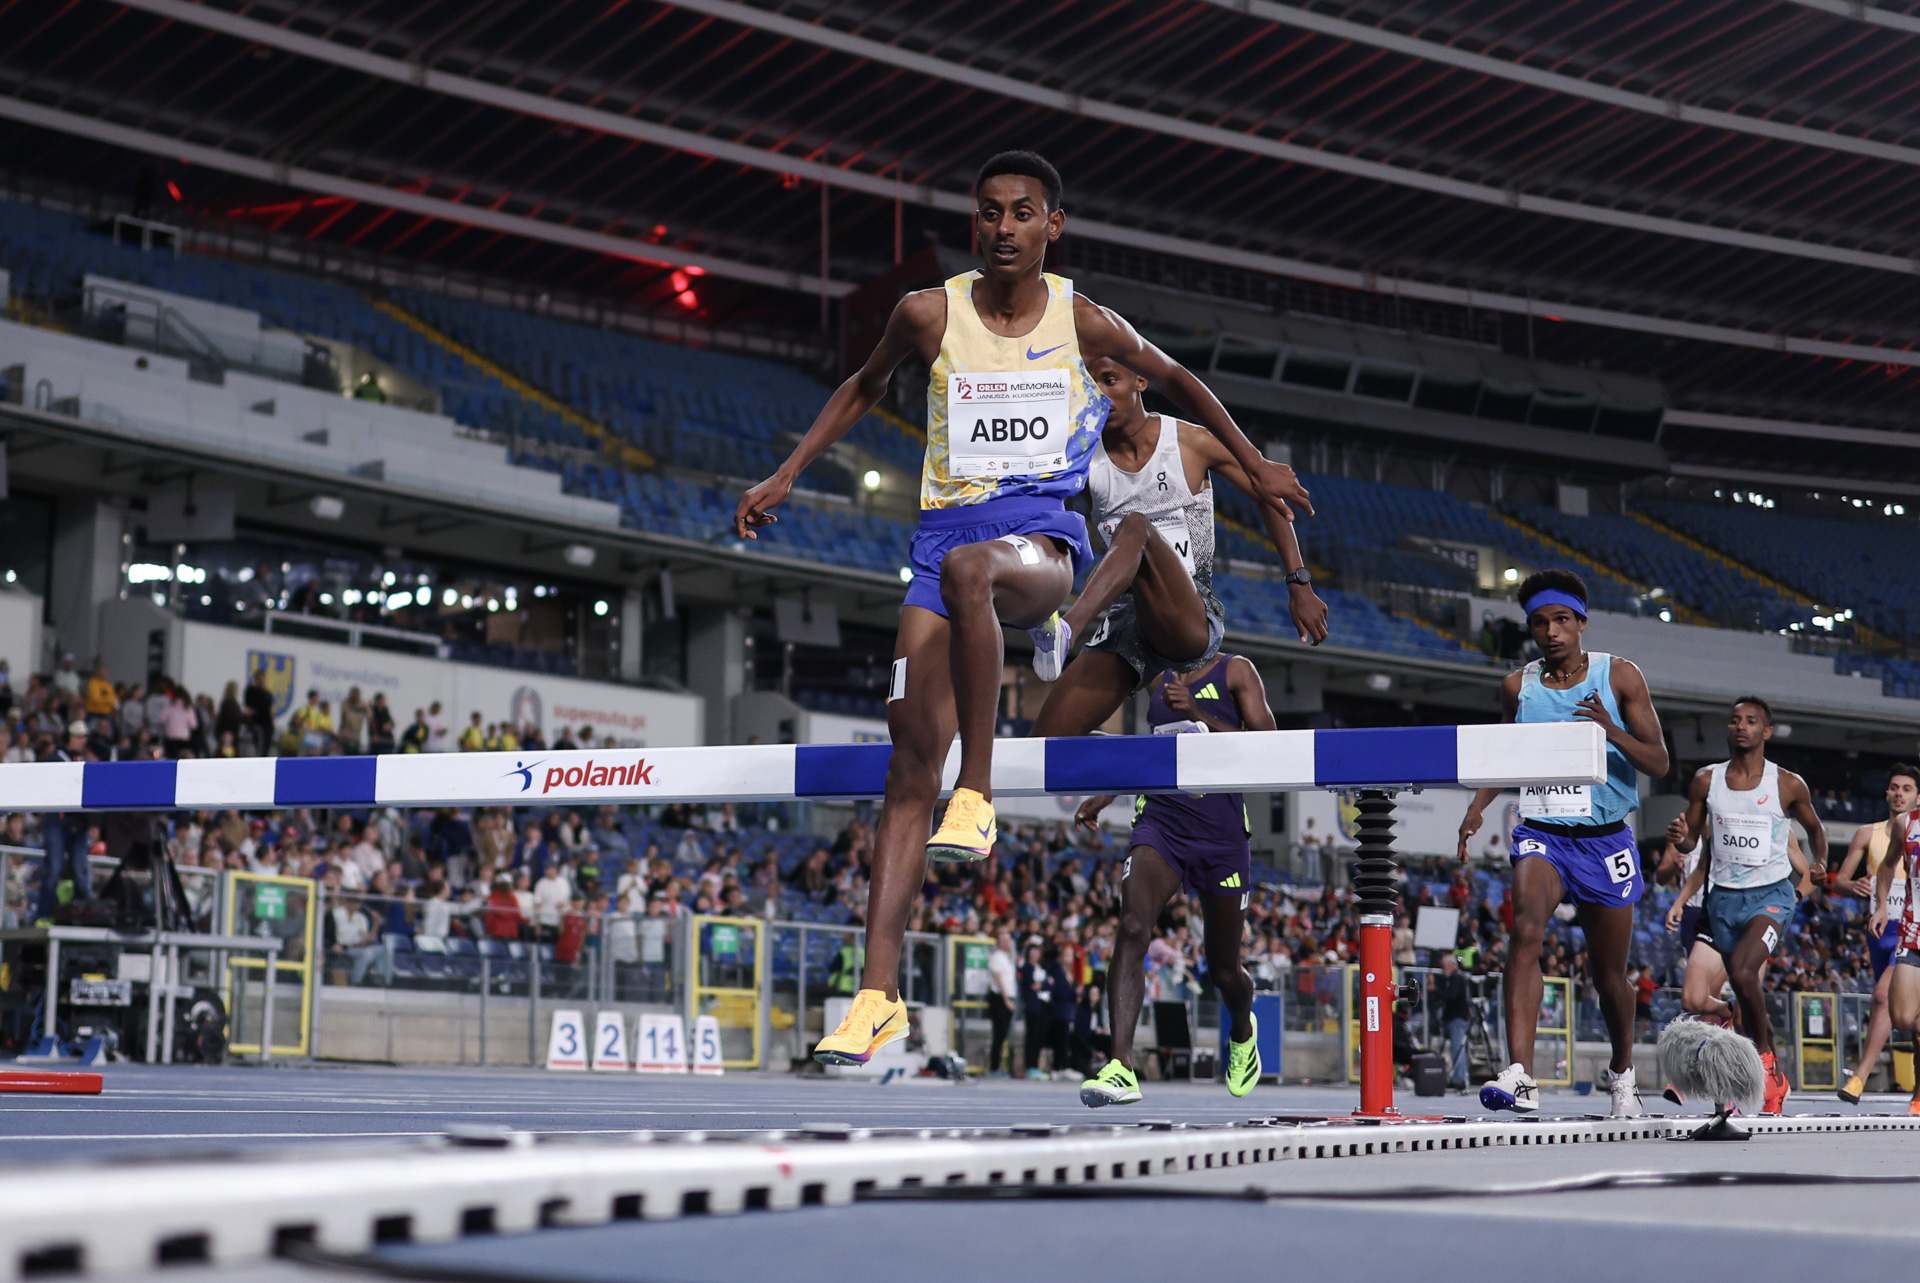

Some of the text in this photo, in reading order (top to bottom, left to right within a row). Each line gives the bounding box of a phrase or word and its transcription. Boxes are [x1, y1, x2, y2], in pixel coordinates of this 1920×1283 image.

[978, 384, 1006, 392] ORLEN
[970, 416, 1049, 443] ABDO
[543, 758, 655, 794] polanik
[1722, 834, 1759, 849] SADO
[1613, 853, 1630, 878] 5
[559, 1023, 577, 1056] 3
[603, 1025, 619, 1057] 2
[701, 1029, 717, 1060] 5
